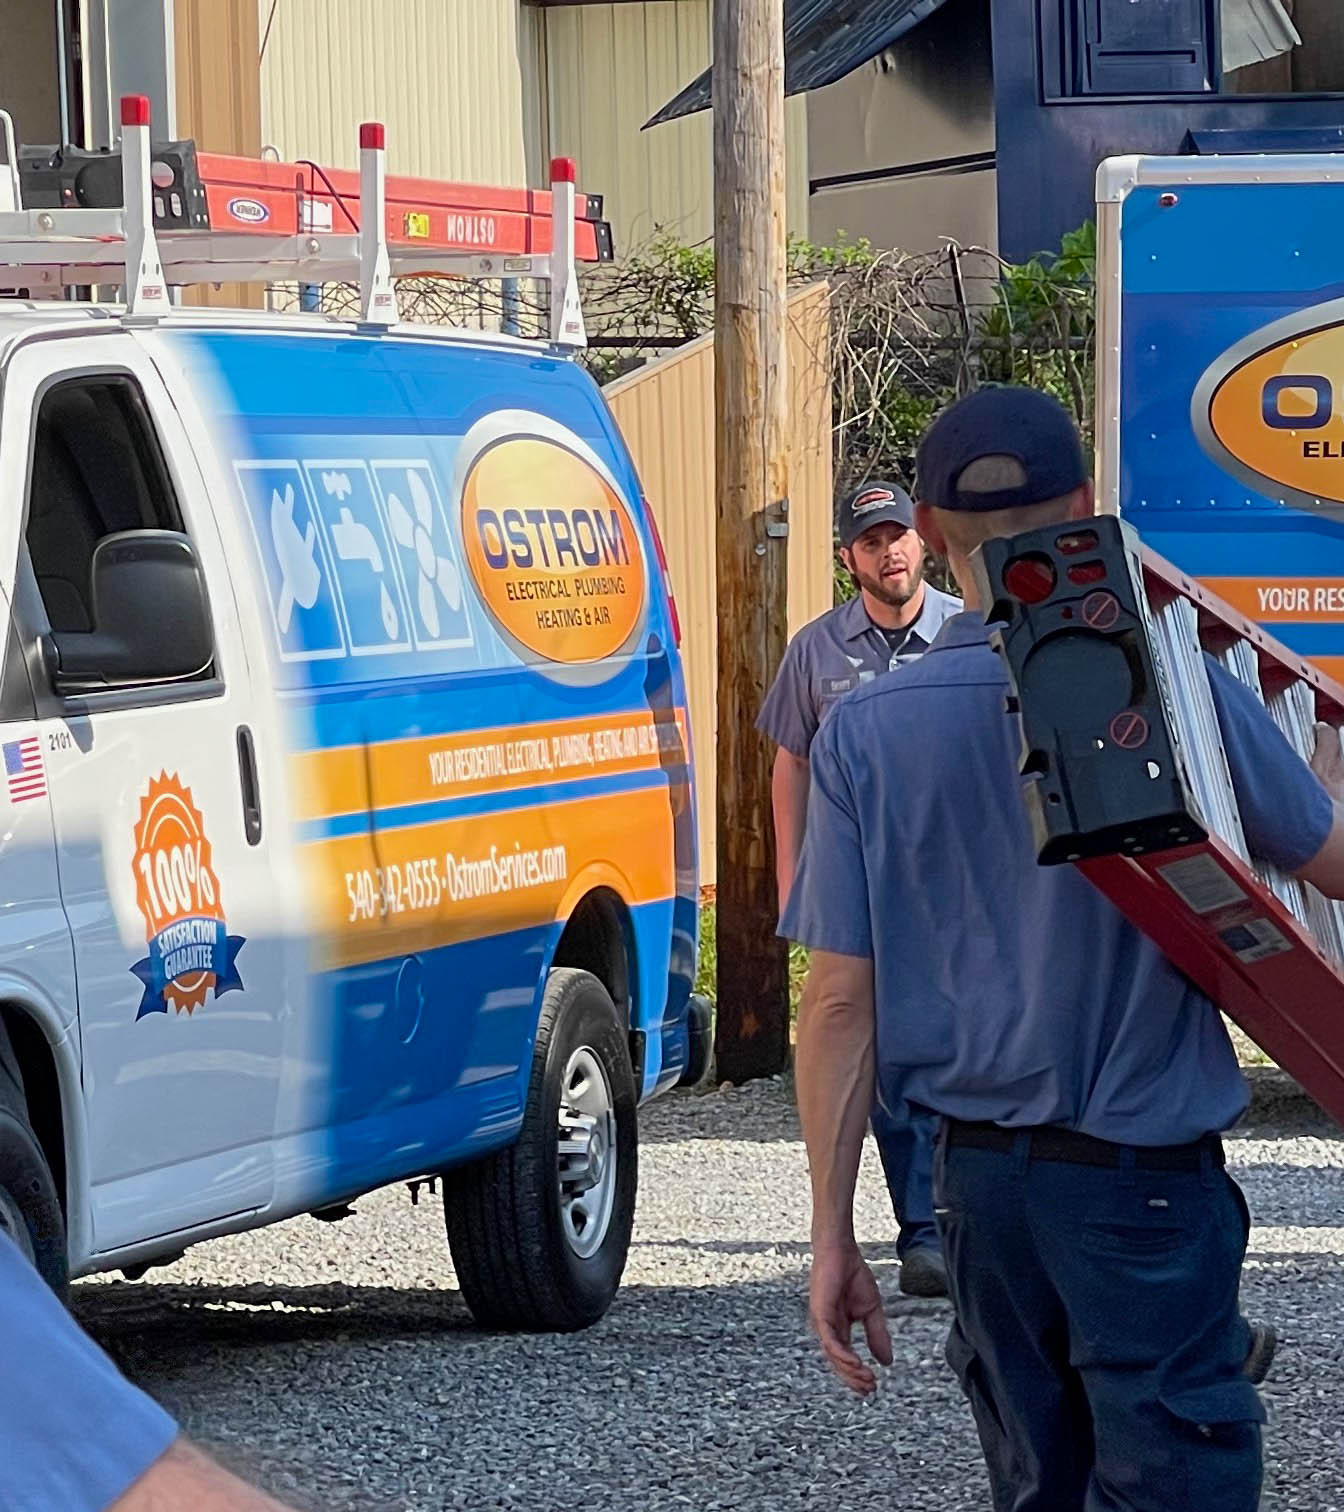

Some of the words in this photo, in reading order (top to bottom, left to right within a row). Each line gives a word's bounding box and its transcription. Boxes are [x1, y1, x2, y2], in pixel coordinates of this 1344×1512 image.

[447, 214, 495, 245] OSTROM
[476, 508, 630, 570] OSTROM
[506, 580, 571, 601] ELECTRICAL
[575, 577, 626, 597] PLUMBING
[1257, 588, 1309, 612] YOUR
[536, 609, 582, 629] HEATING
[584, 607, 592, 625] &
[594, 606, 612, 625] AIR
[48, 731, 72, 751] 2101
[428, 750, 455, 784] YOUR
[454, 743, 507, 781] RESIDENTIAL
[593, 728, 625, 762] HEATING
[139, 838, 216, 919] 100%
[345, 857, 441, 923] 540-342-0555
[446, 841, 567, 902] OstromServices.com
[158, 919, 217, 959] SATISFACTION
[164, 944, 213, 980] GUARANTEE
